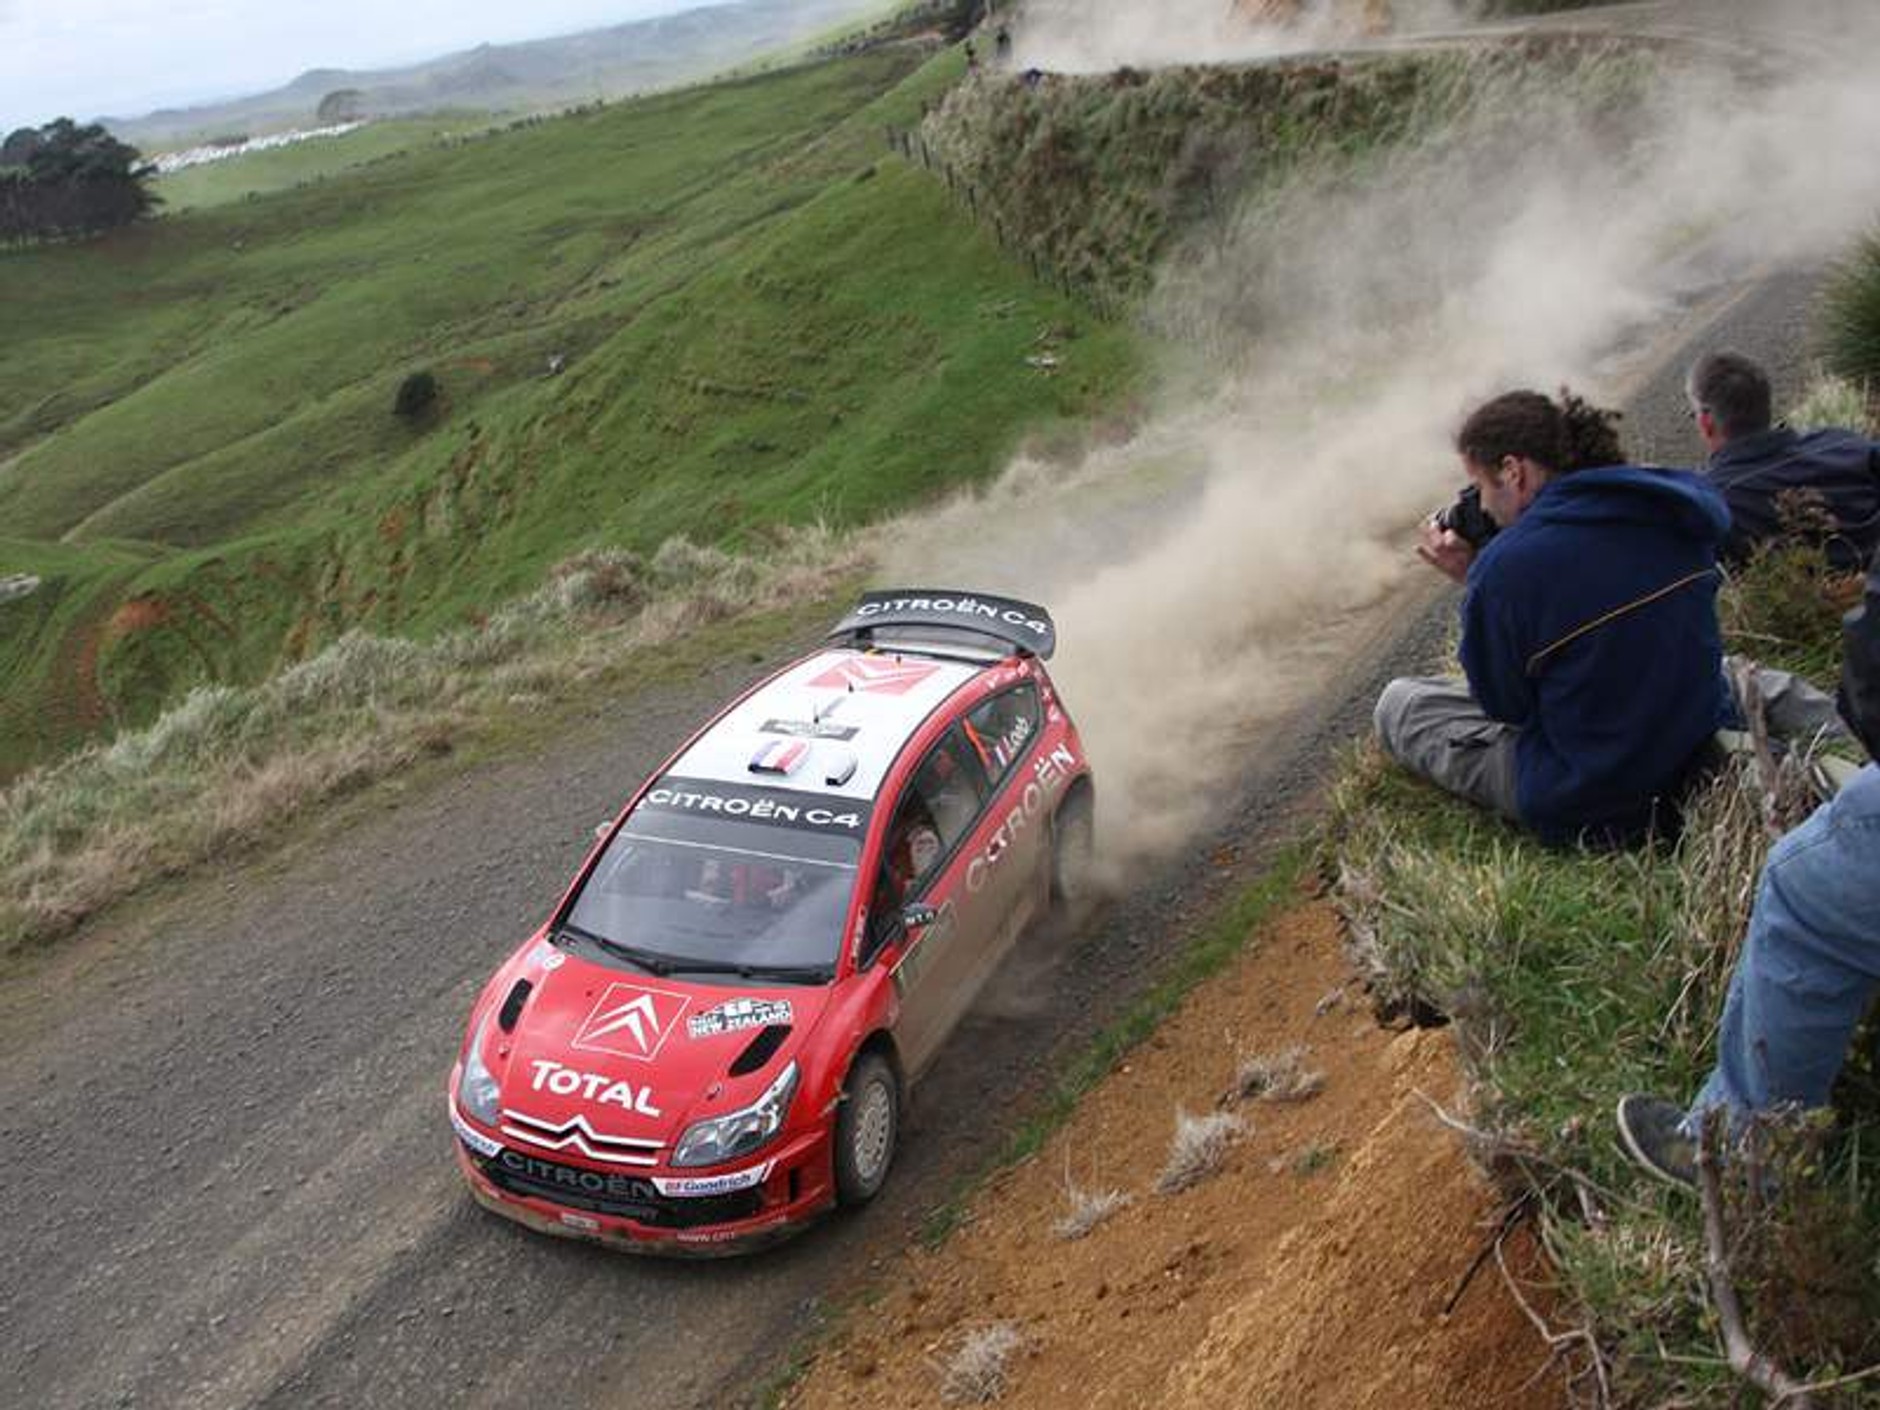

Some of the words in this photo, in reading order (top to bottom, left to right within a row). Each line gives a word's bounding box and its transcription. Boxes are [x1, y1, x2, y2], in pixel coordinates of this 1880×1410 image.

[857, 598, 998, 618] CITROËN
[1003, 610, 1048, 634] C4
[648, 789, 800, 822] CITROËN
[805, 809, 863, 829] C4
[531, 1060, 661, 1117] TOTAL
[502, 1151, 657, 1198] CITROËN
